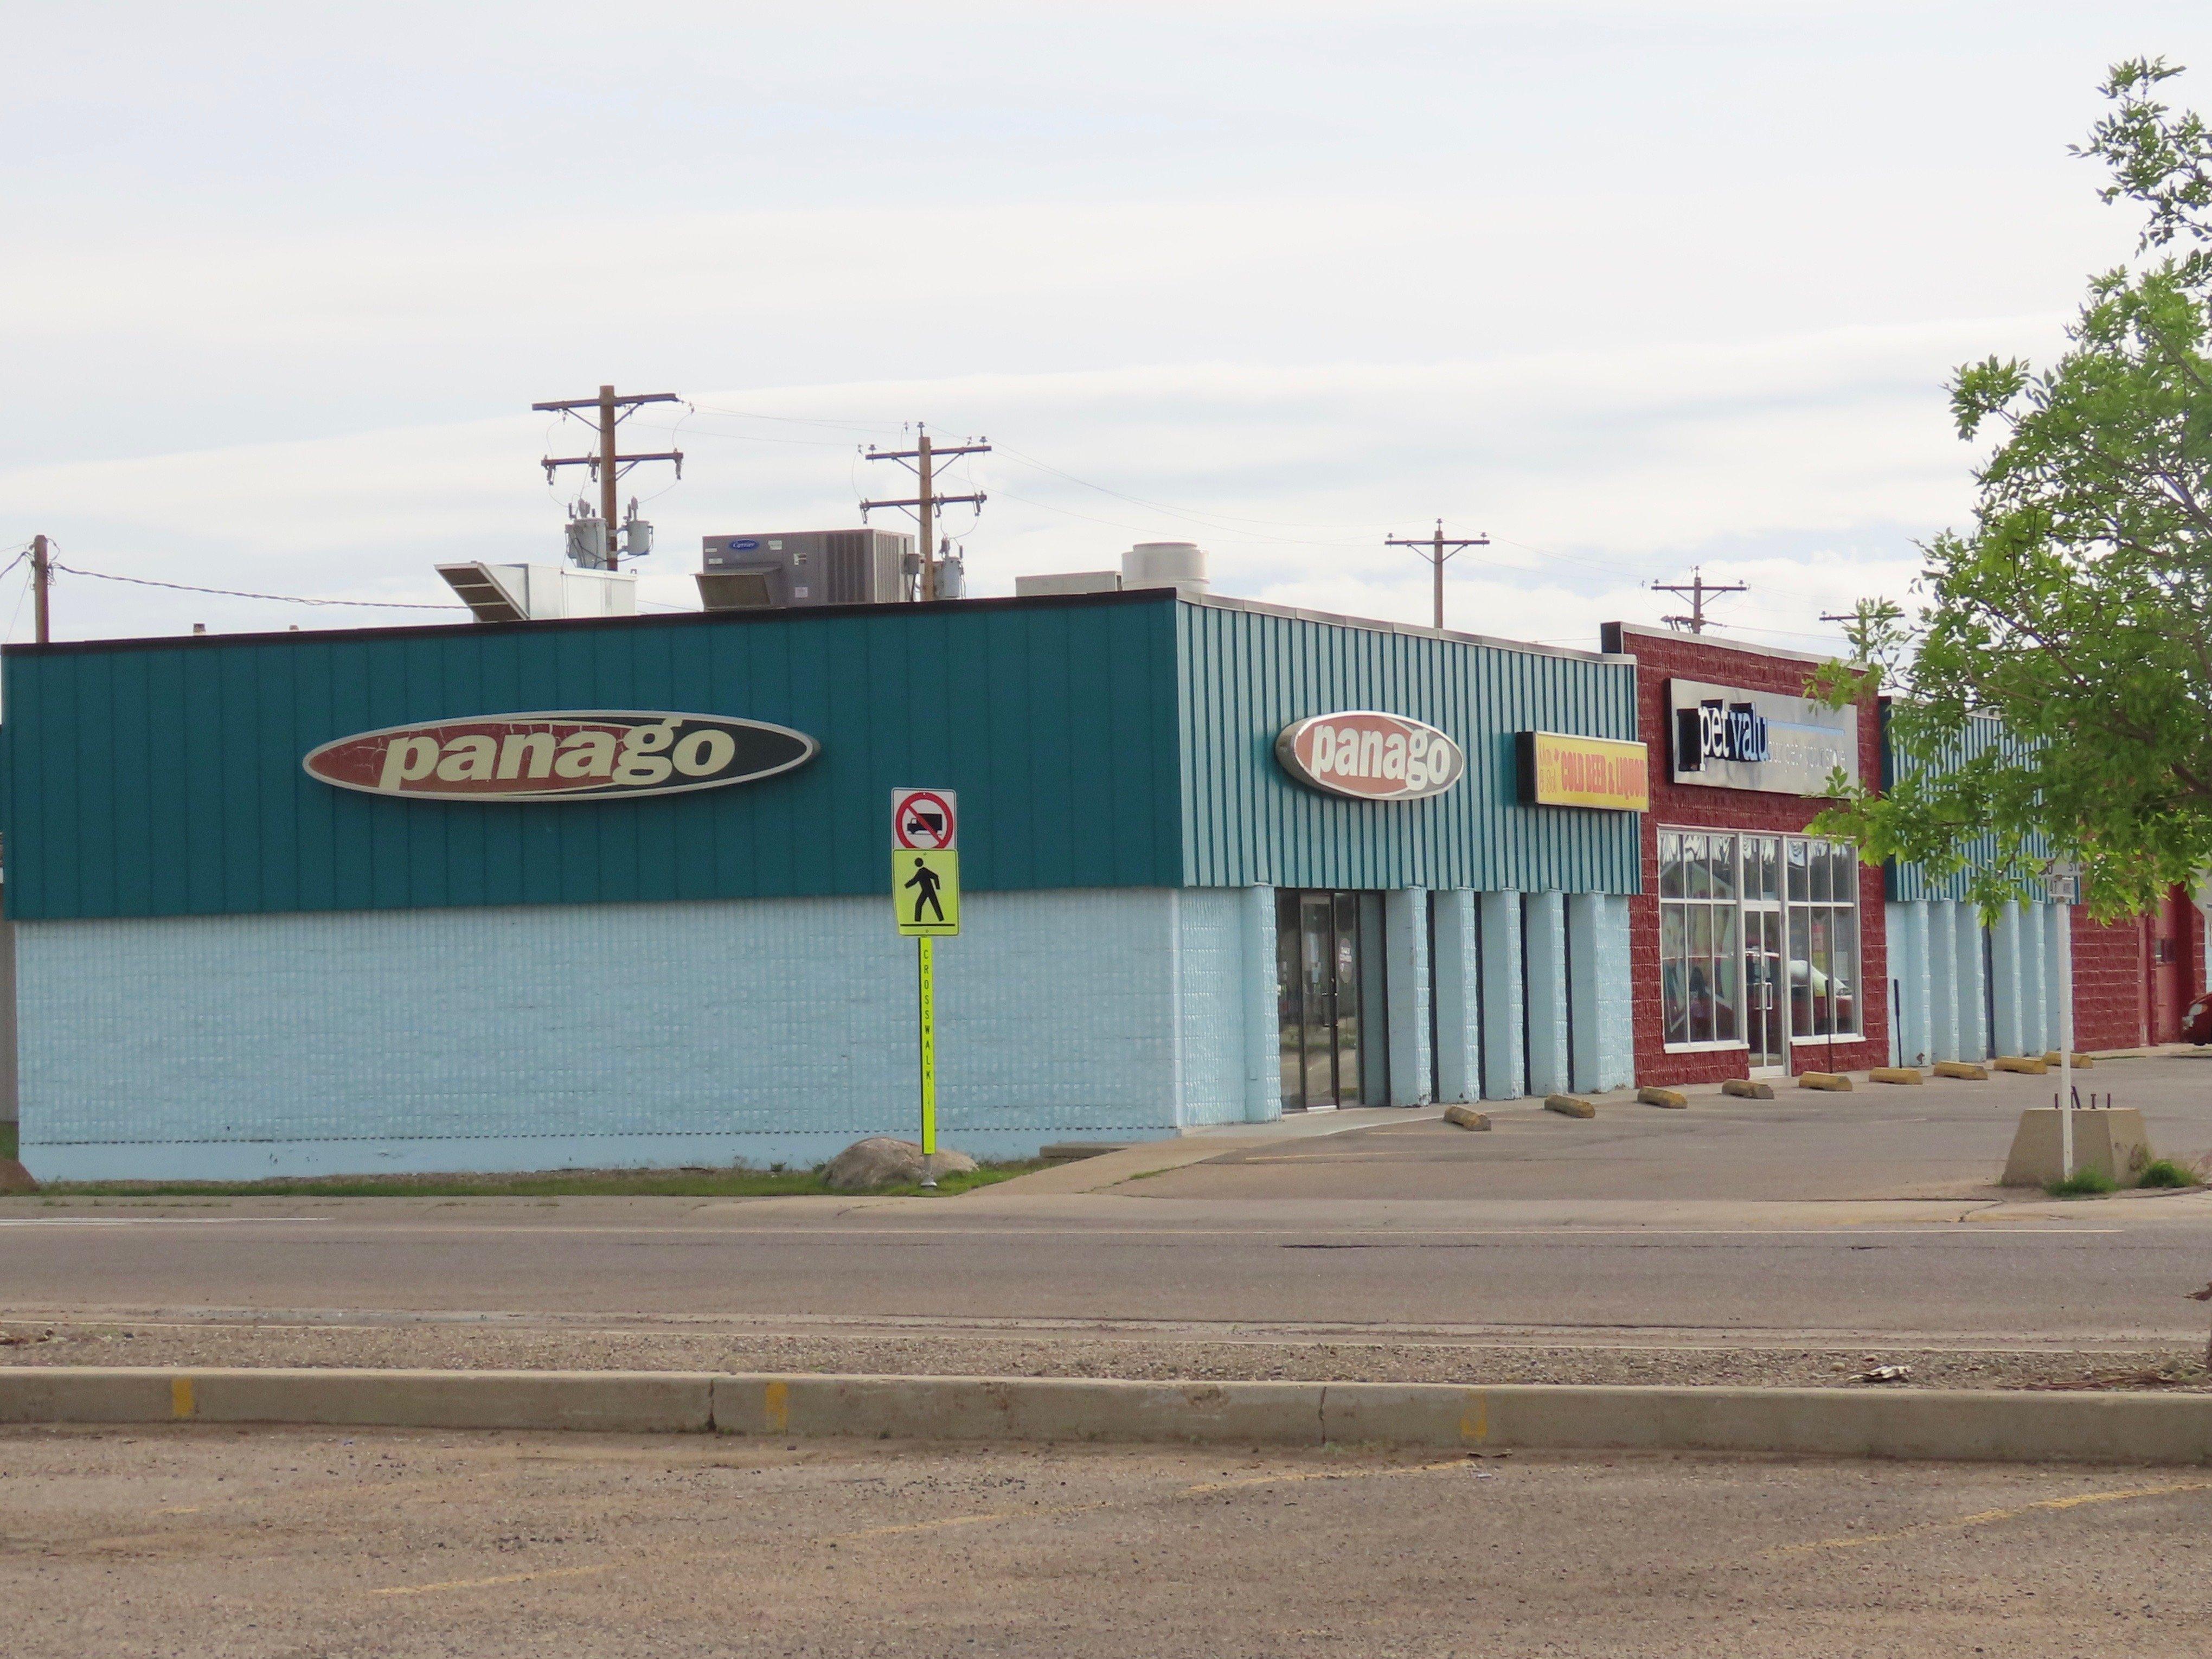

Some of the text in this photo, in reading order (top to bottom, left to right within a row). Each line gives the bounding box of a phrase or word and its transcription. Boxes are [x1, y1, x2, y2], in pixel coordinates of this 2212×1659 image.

[380, 717, 735, 791] panago
[1311, 725, 1451, 791] panago
[1698, 699, 1729, 771] pet
[1730, 702, 1770, 761] valu
